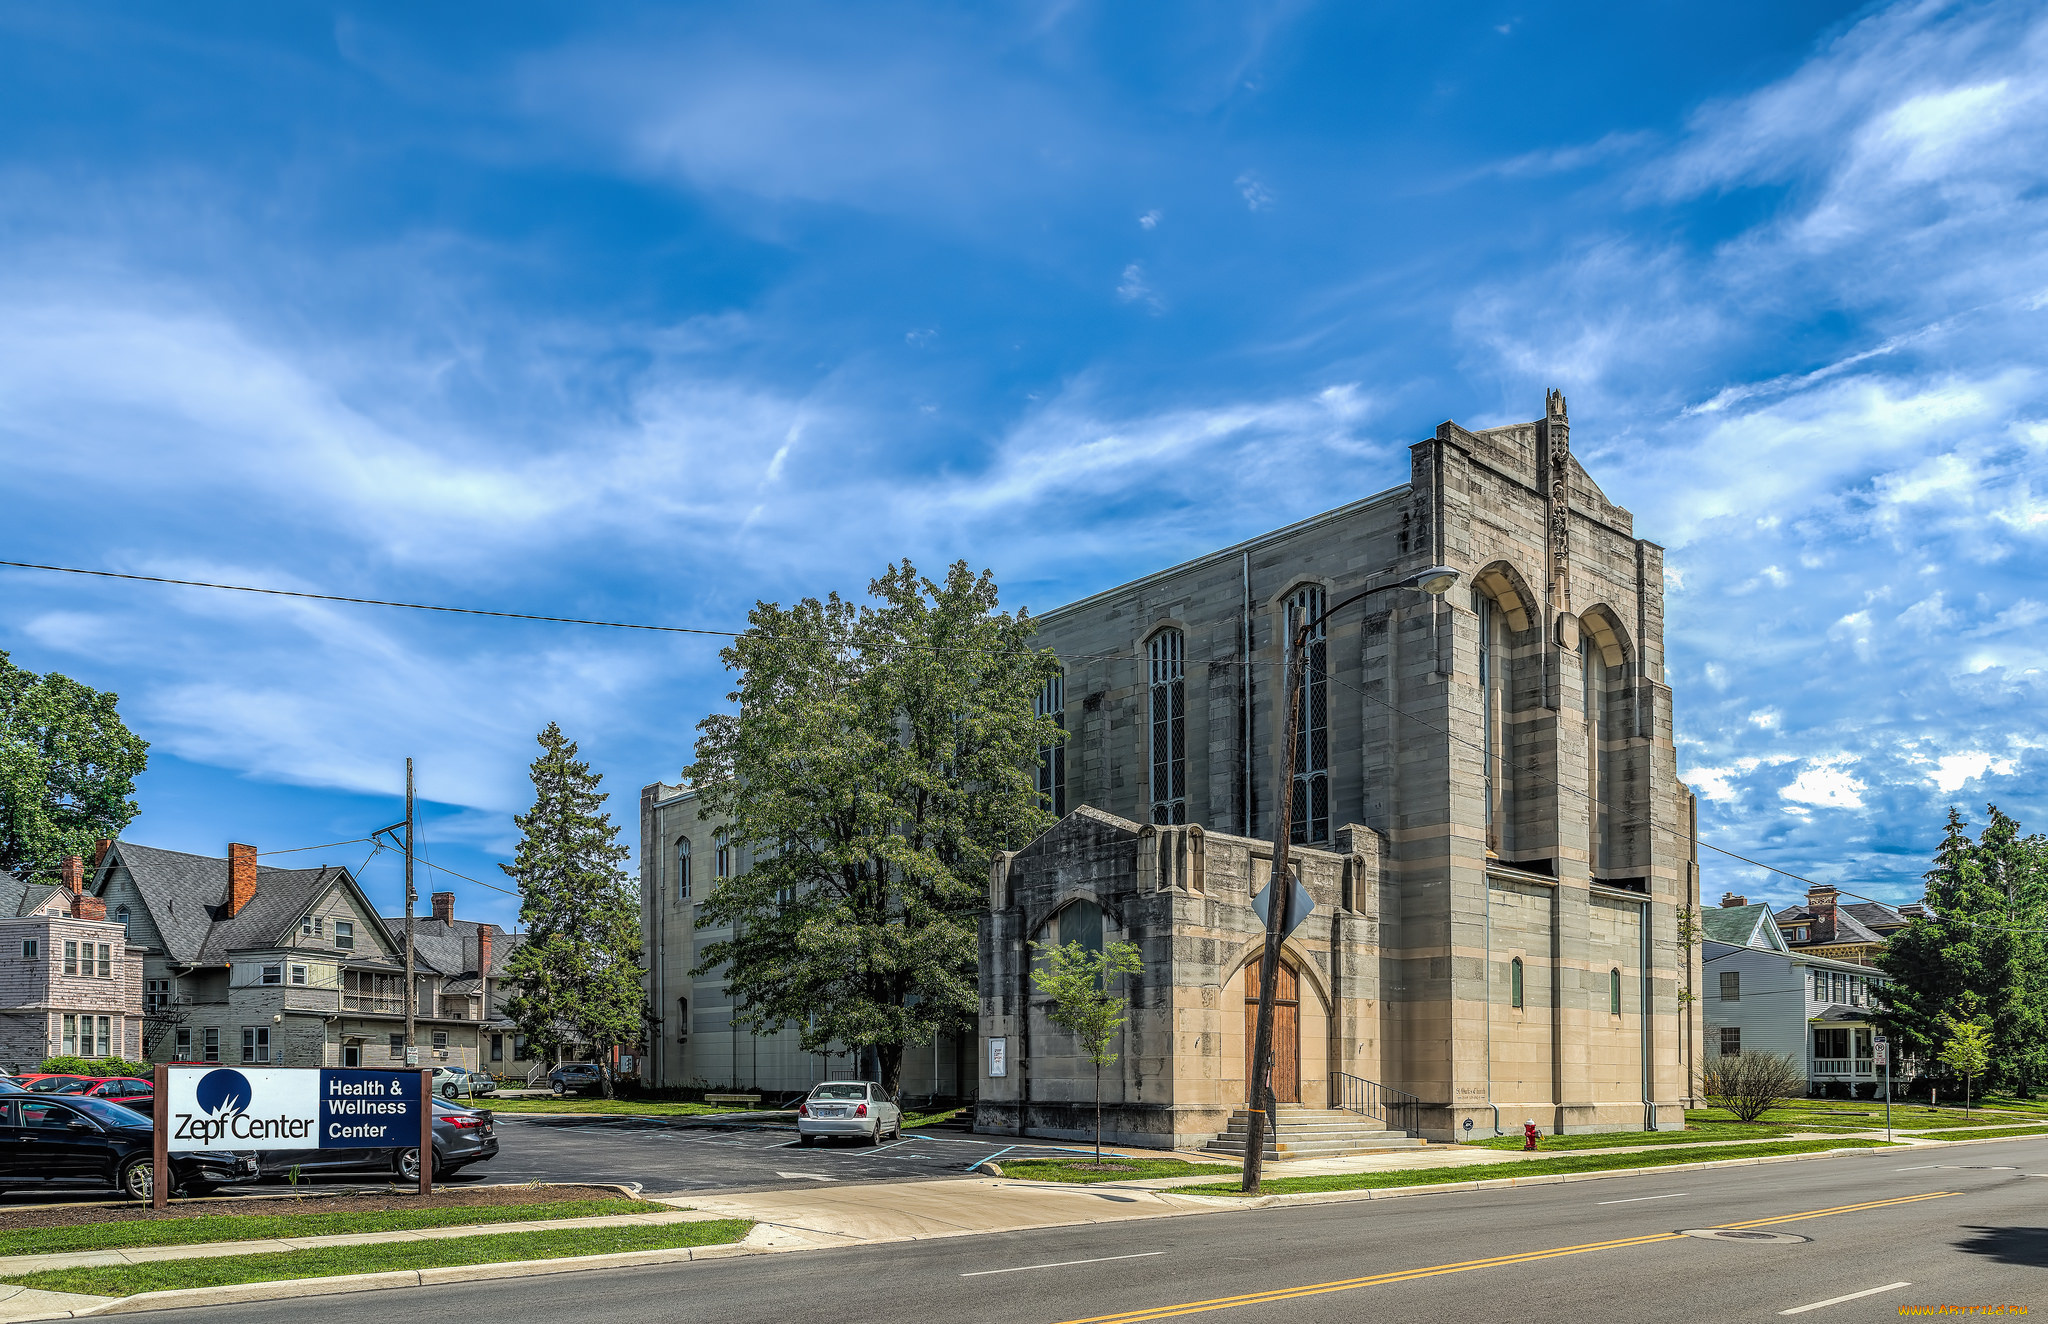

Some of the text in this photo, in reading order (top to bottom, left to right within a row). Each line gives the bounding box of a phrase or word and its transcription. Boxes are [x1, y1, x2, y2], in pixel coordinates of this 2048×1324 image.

[329, 1080, 403, 1096] Health &
[328, 1099, 407, 1115] Wellness
[174, 1112, 315, 1146] Zepf Center
[328, 1122, 388, 1139] Center
